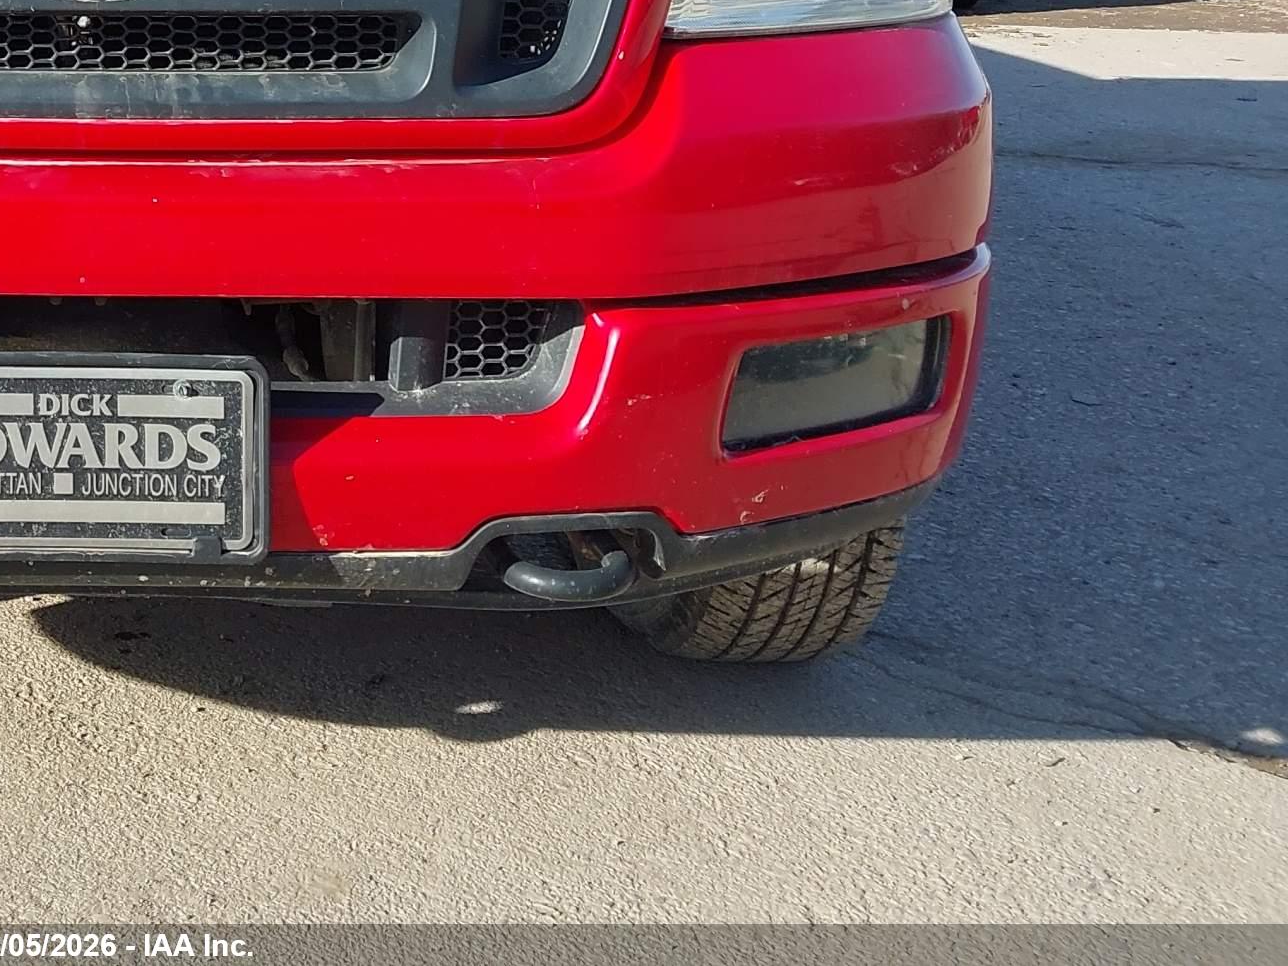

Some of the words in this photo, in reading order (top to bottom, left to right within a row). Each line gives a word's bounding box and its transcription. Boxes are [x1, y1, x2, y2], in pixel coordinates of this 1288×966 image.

[37, 393, 114, 417] DICK
[81, 473, 178, 497] JUNCTION
[183, 474, 226, 498] CITY
